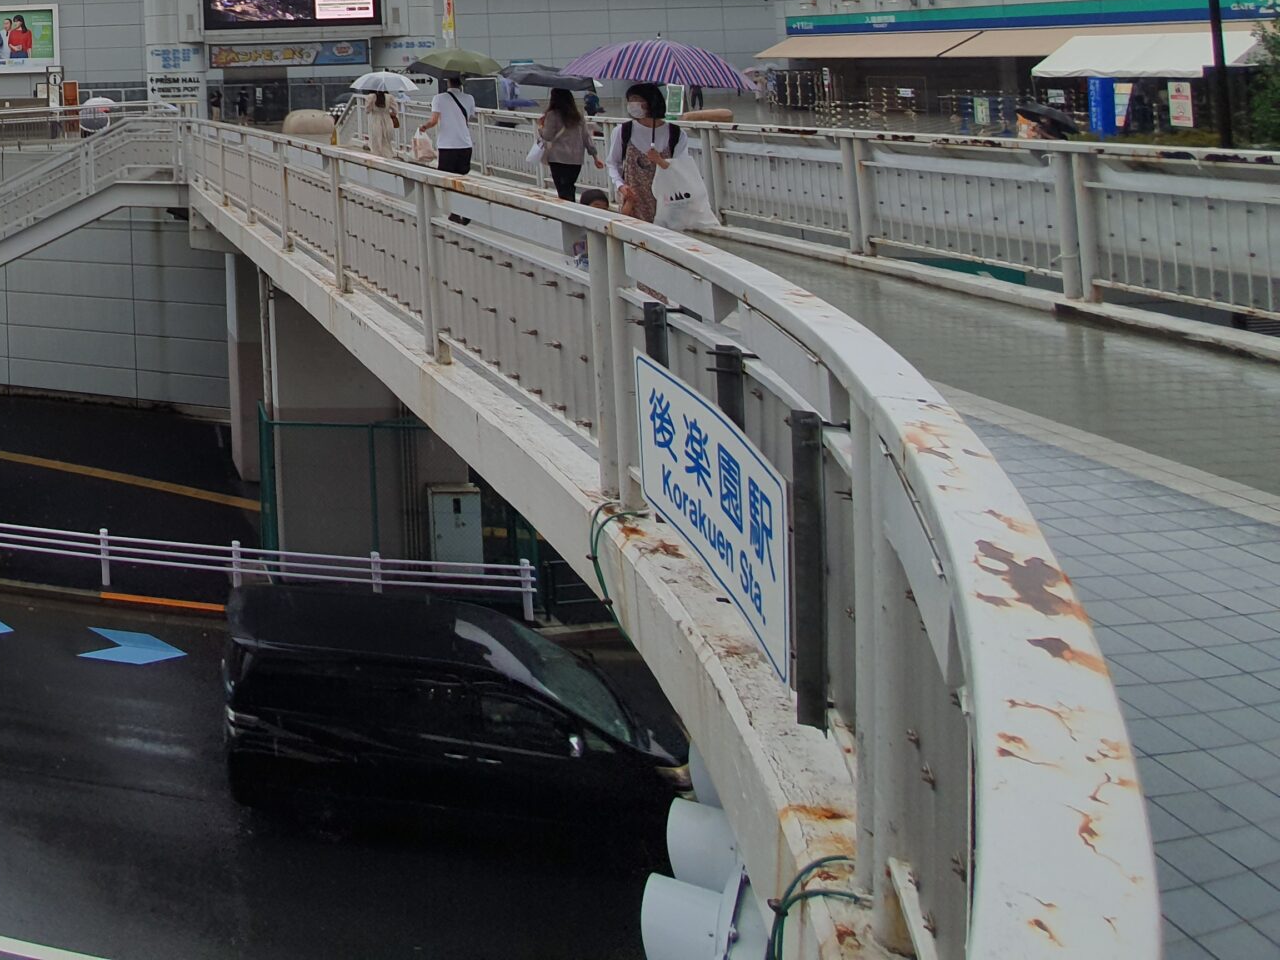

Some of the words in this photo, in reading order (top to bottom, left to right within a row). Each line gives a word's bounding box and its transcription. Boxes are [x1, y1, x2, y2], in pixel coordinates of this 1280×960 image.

[648, 386, 776, 582] 後楽園駅
[661, 464, 734, 573] Korakuen
[739, 549, 766, 626] Sta.
